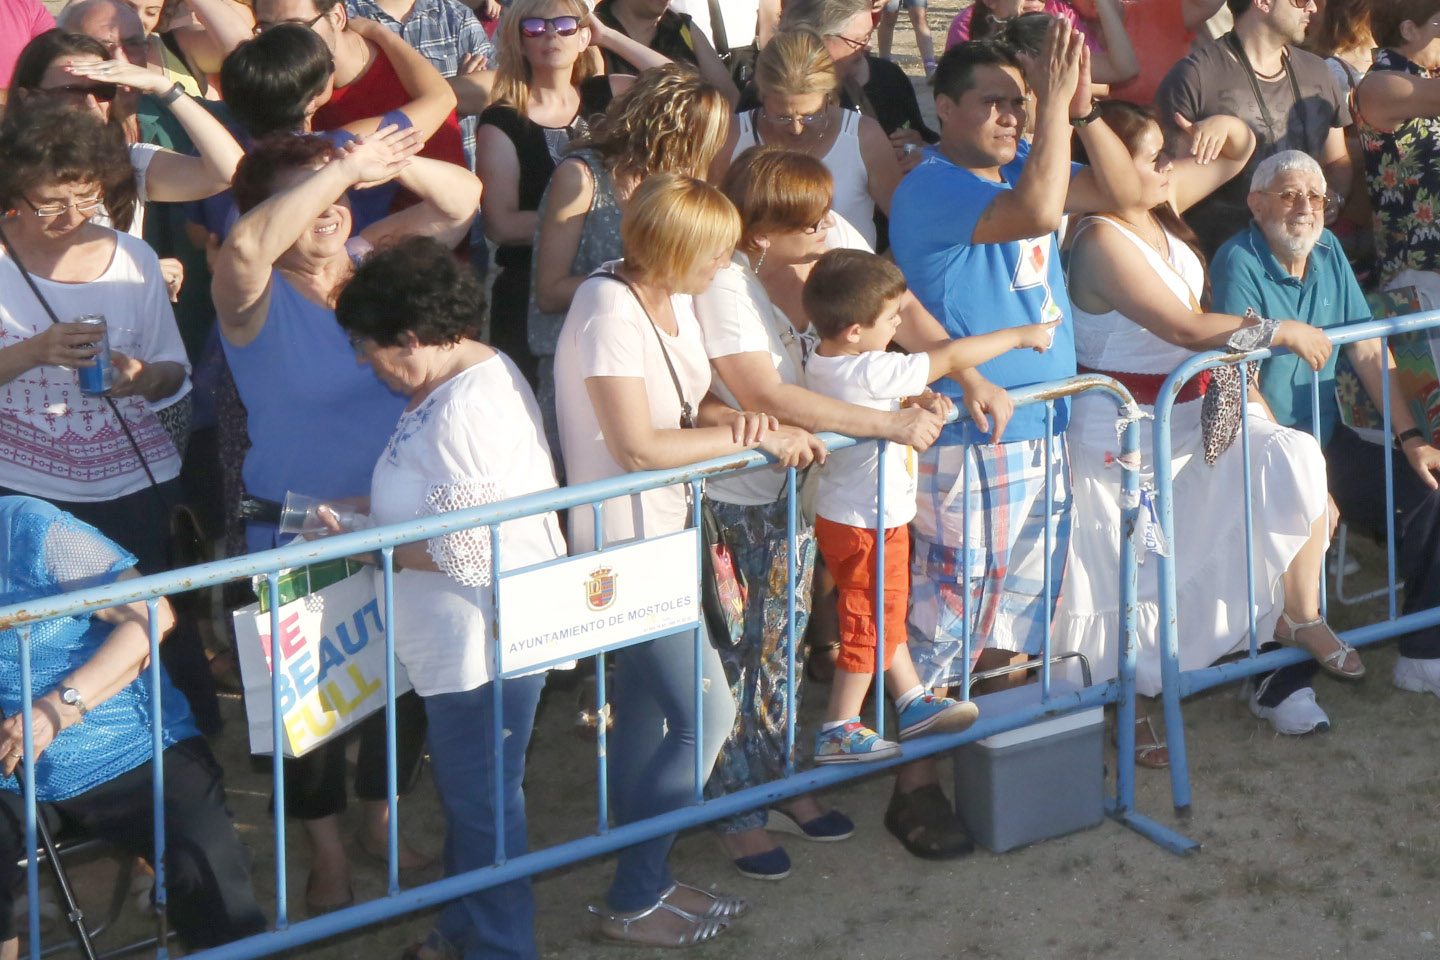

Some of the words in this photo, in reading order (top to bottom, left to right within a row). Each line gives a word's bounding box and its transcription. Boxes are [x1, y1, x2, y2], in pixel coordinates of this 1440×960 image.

[509, 619, 605, 654] AYUNTAMIENTO
[609, 613, 625, 627] DE
[628, 595, 692, 621] MOSTOLES
[284, 663, 382, 757] FULL
